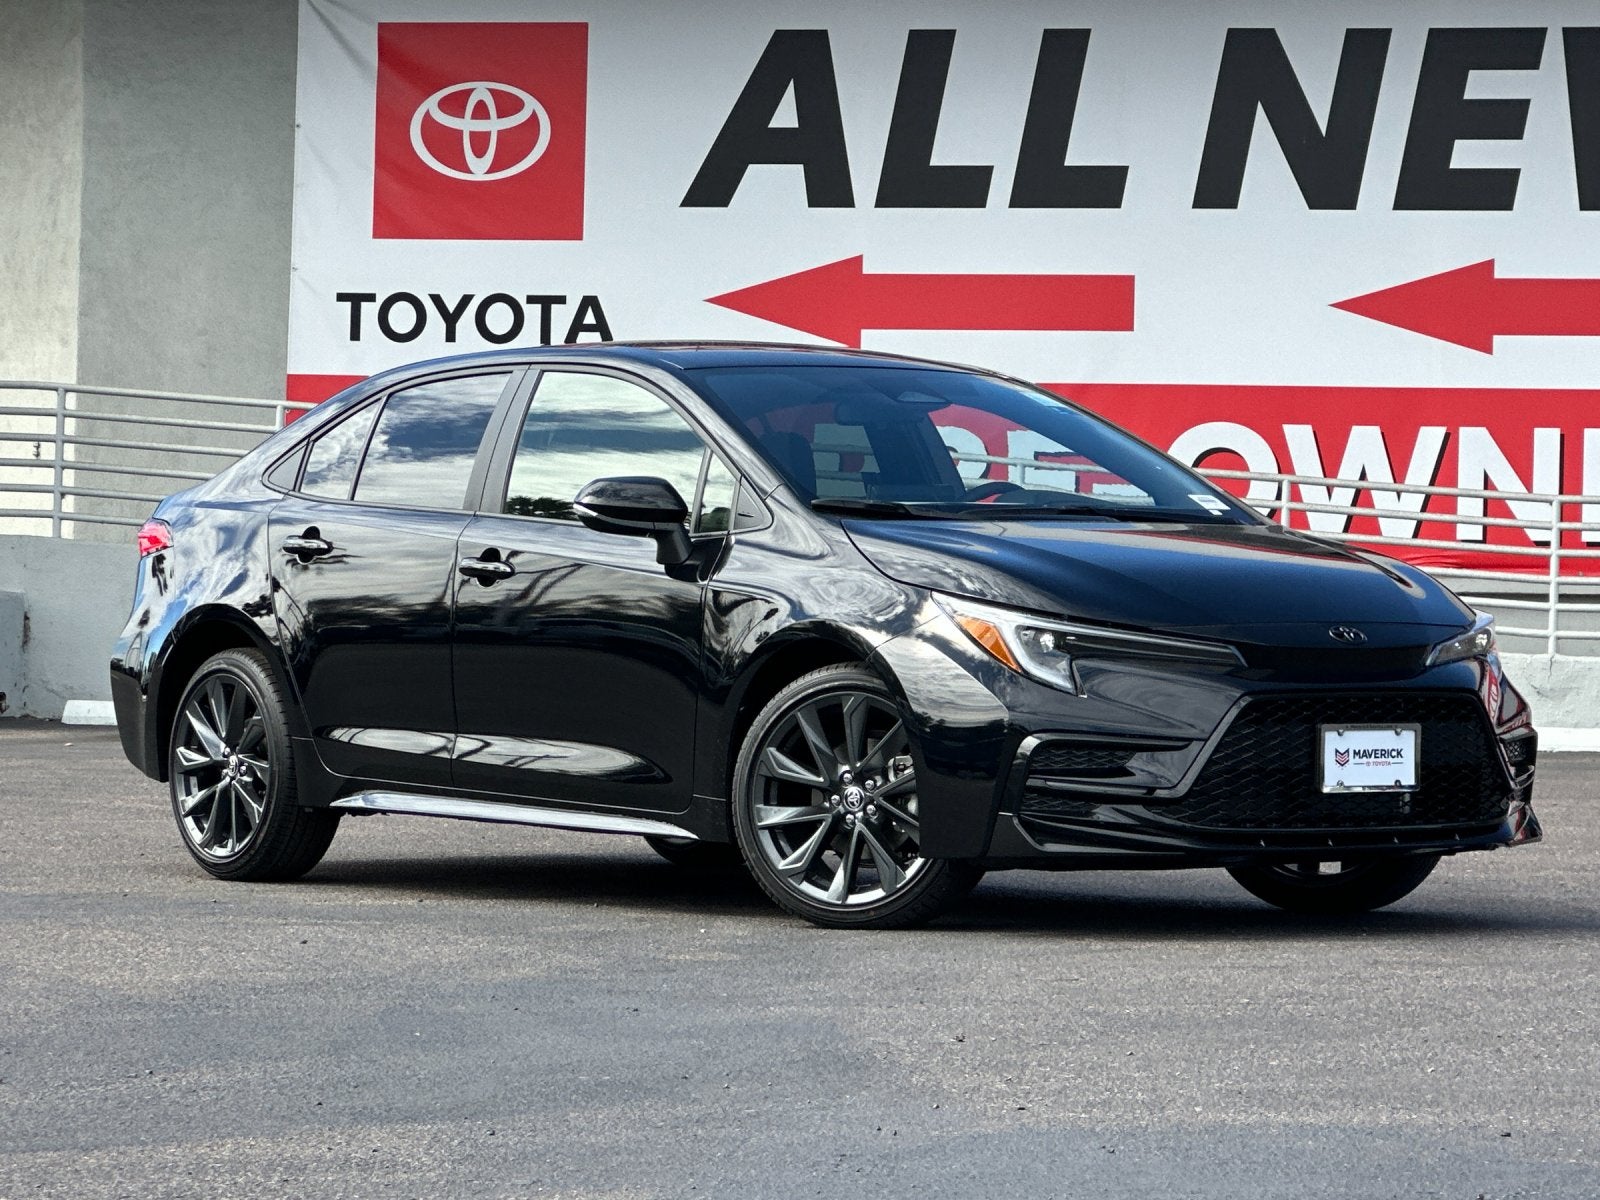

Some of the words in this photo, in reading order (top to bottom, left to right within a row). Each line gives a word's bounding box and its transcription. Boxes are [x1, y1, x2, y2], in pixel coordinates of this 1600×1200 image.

[679, 28, 1130, 209] ALL
[336, 291, 614, 346] TOYOTA
[1352, 747, 1404, 760] MAVERICK
